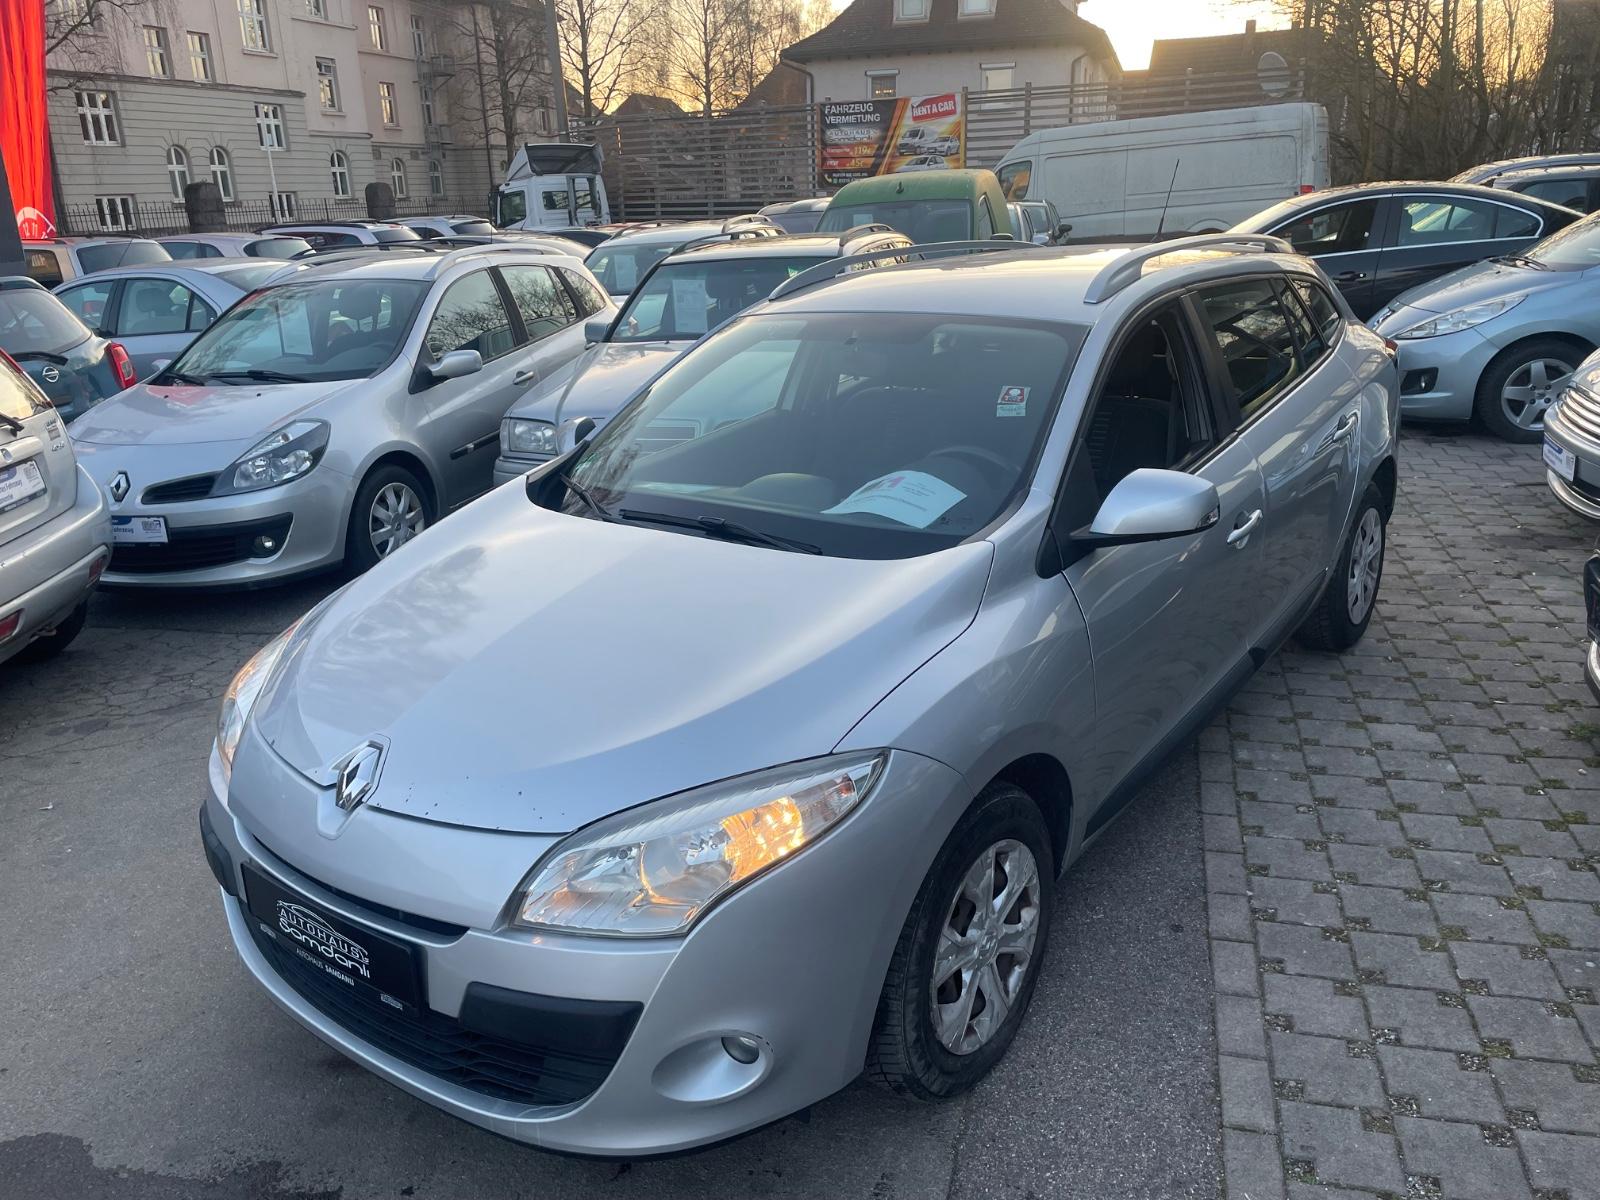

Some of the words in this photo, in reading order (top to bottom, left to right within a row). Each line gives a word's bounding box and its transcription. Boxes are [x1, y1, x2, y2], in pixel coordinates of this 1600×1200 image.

[825, 103, 873, 114] FAHRZEUG
[912, 104, 932, 117] RENT
[938, 100, 955, 112] CAR
[826, 114, 881, 124] VERMIETUNG
[279, 908, 360, 959] AUTOHAUS
